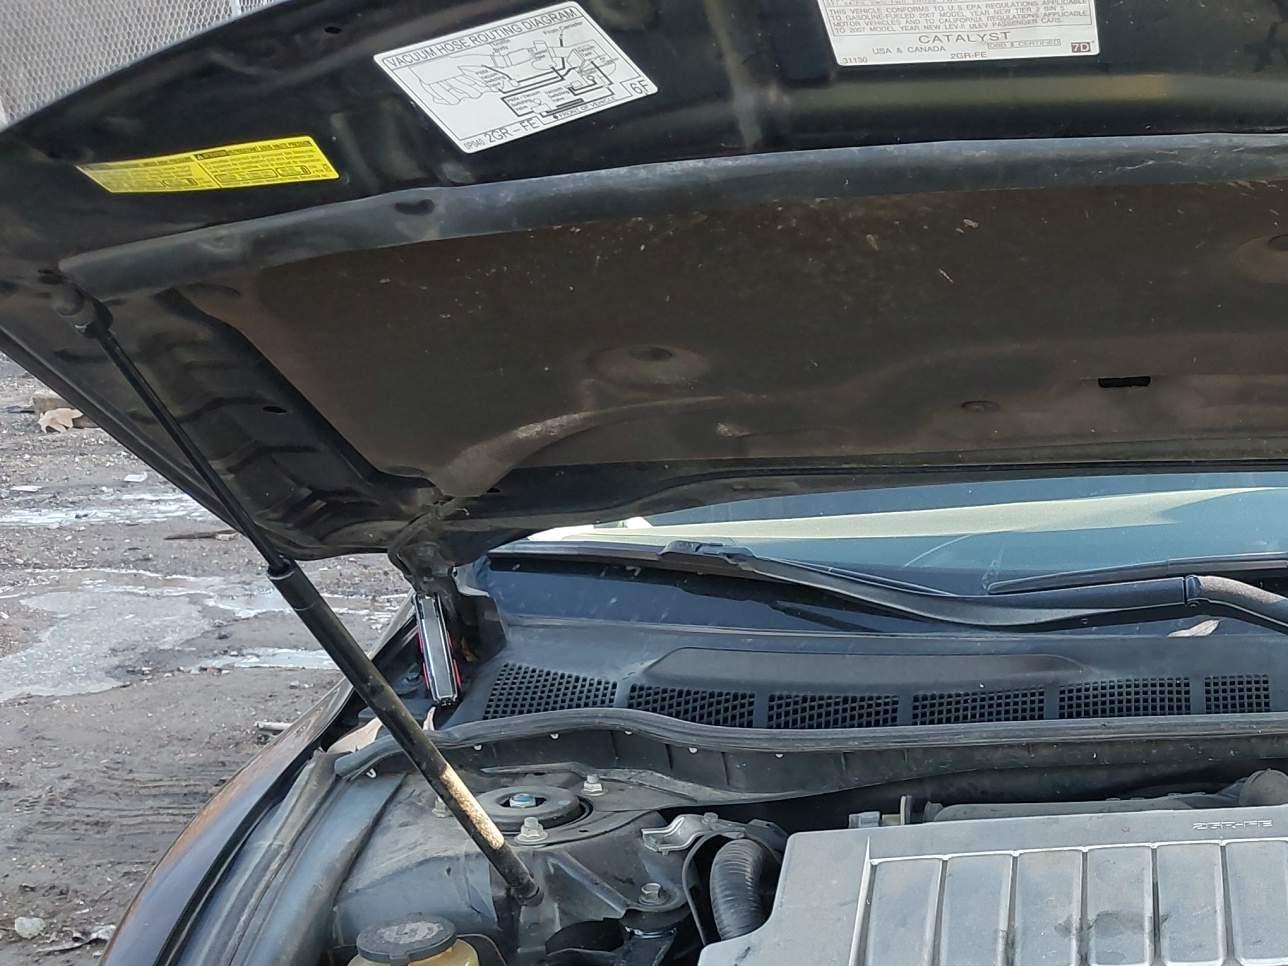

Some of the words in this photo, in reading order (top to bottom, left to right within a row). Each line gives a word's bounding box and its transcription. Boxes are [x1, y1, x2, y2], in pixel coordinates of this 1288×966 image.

[987, 12, 1040, 20] REGULATIONS
[386, 46, 438, 67] VACUUM
[436, 36, 472, 55] HOSE
[469, 23, 523, 47] ROUTING
[521, 8, 578, 31] DIAGRAM
[918, 31, 1011, 44] CATALYST
[871, 46, 892, 55] USA
[896, 46, 904, 54] &
[906, 44, 946, 54] CANADA
[1071, 42, 1091, 53] 7D
[950, 51, 987, 60] 2GR-FE
[630, 79, 651, 95] 6F
